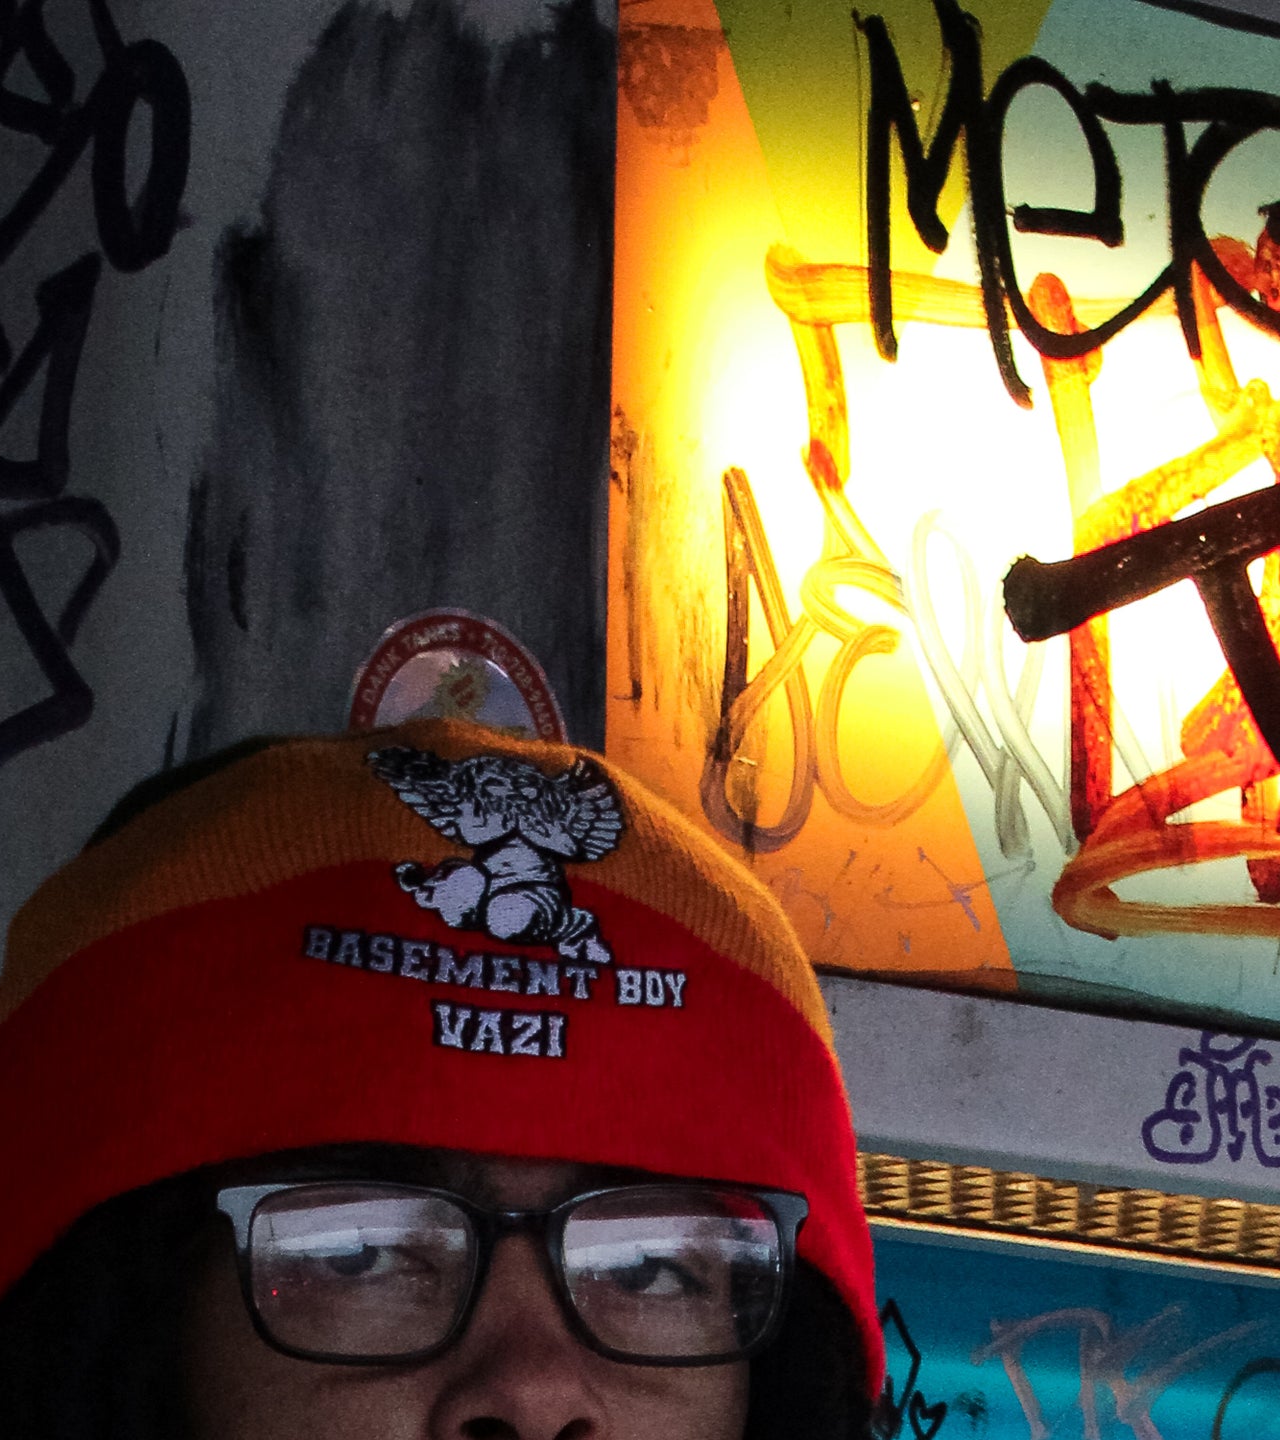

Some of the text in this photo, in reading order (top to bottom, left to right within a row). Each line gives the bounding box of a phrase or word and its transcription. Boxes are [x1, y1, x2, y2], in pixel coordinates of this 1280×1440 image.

[305, 928, 686, 1008] BASEMENT BOY
[433, 1003, 567, 1059] VAZI
